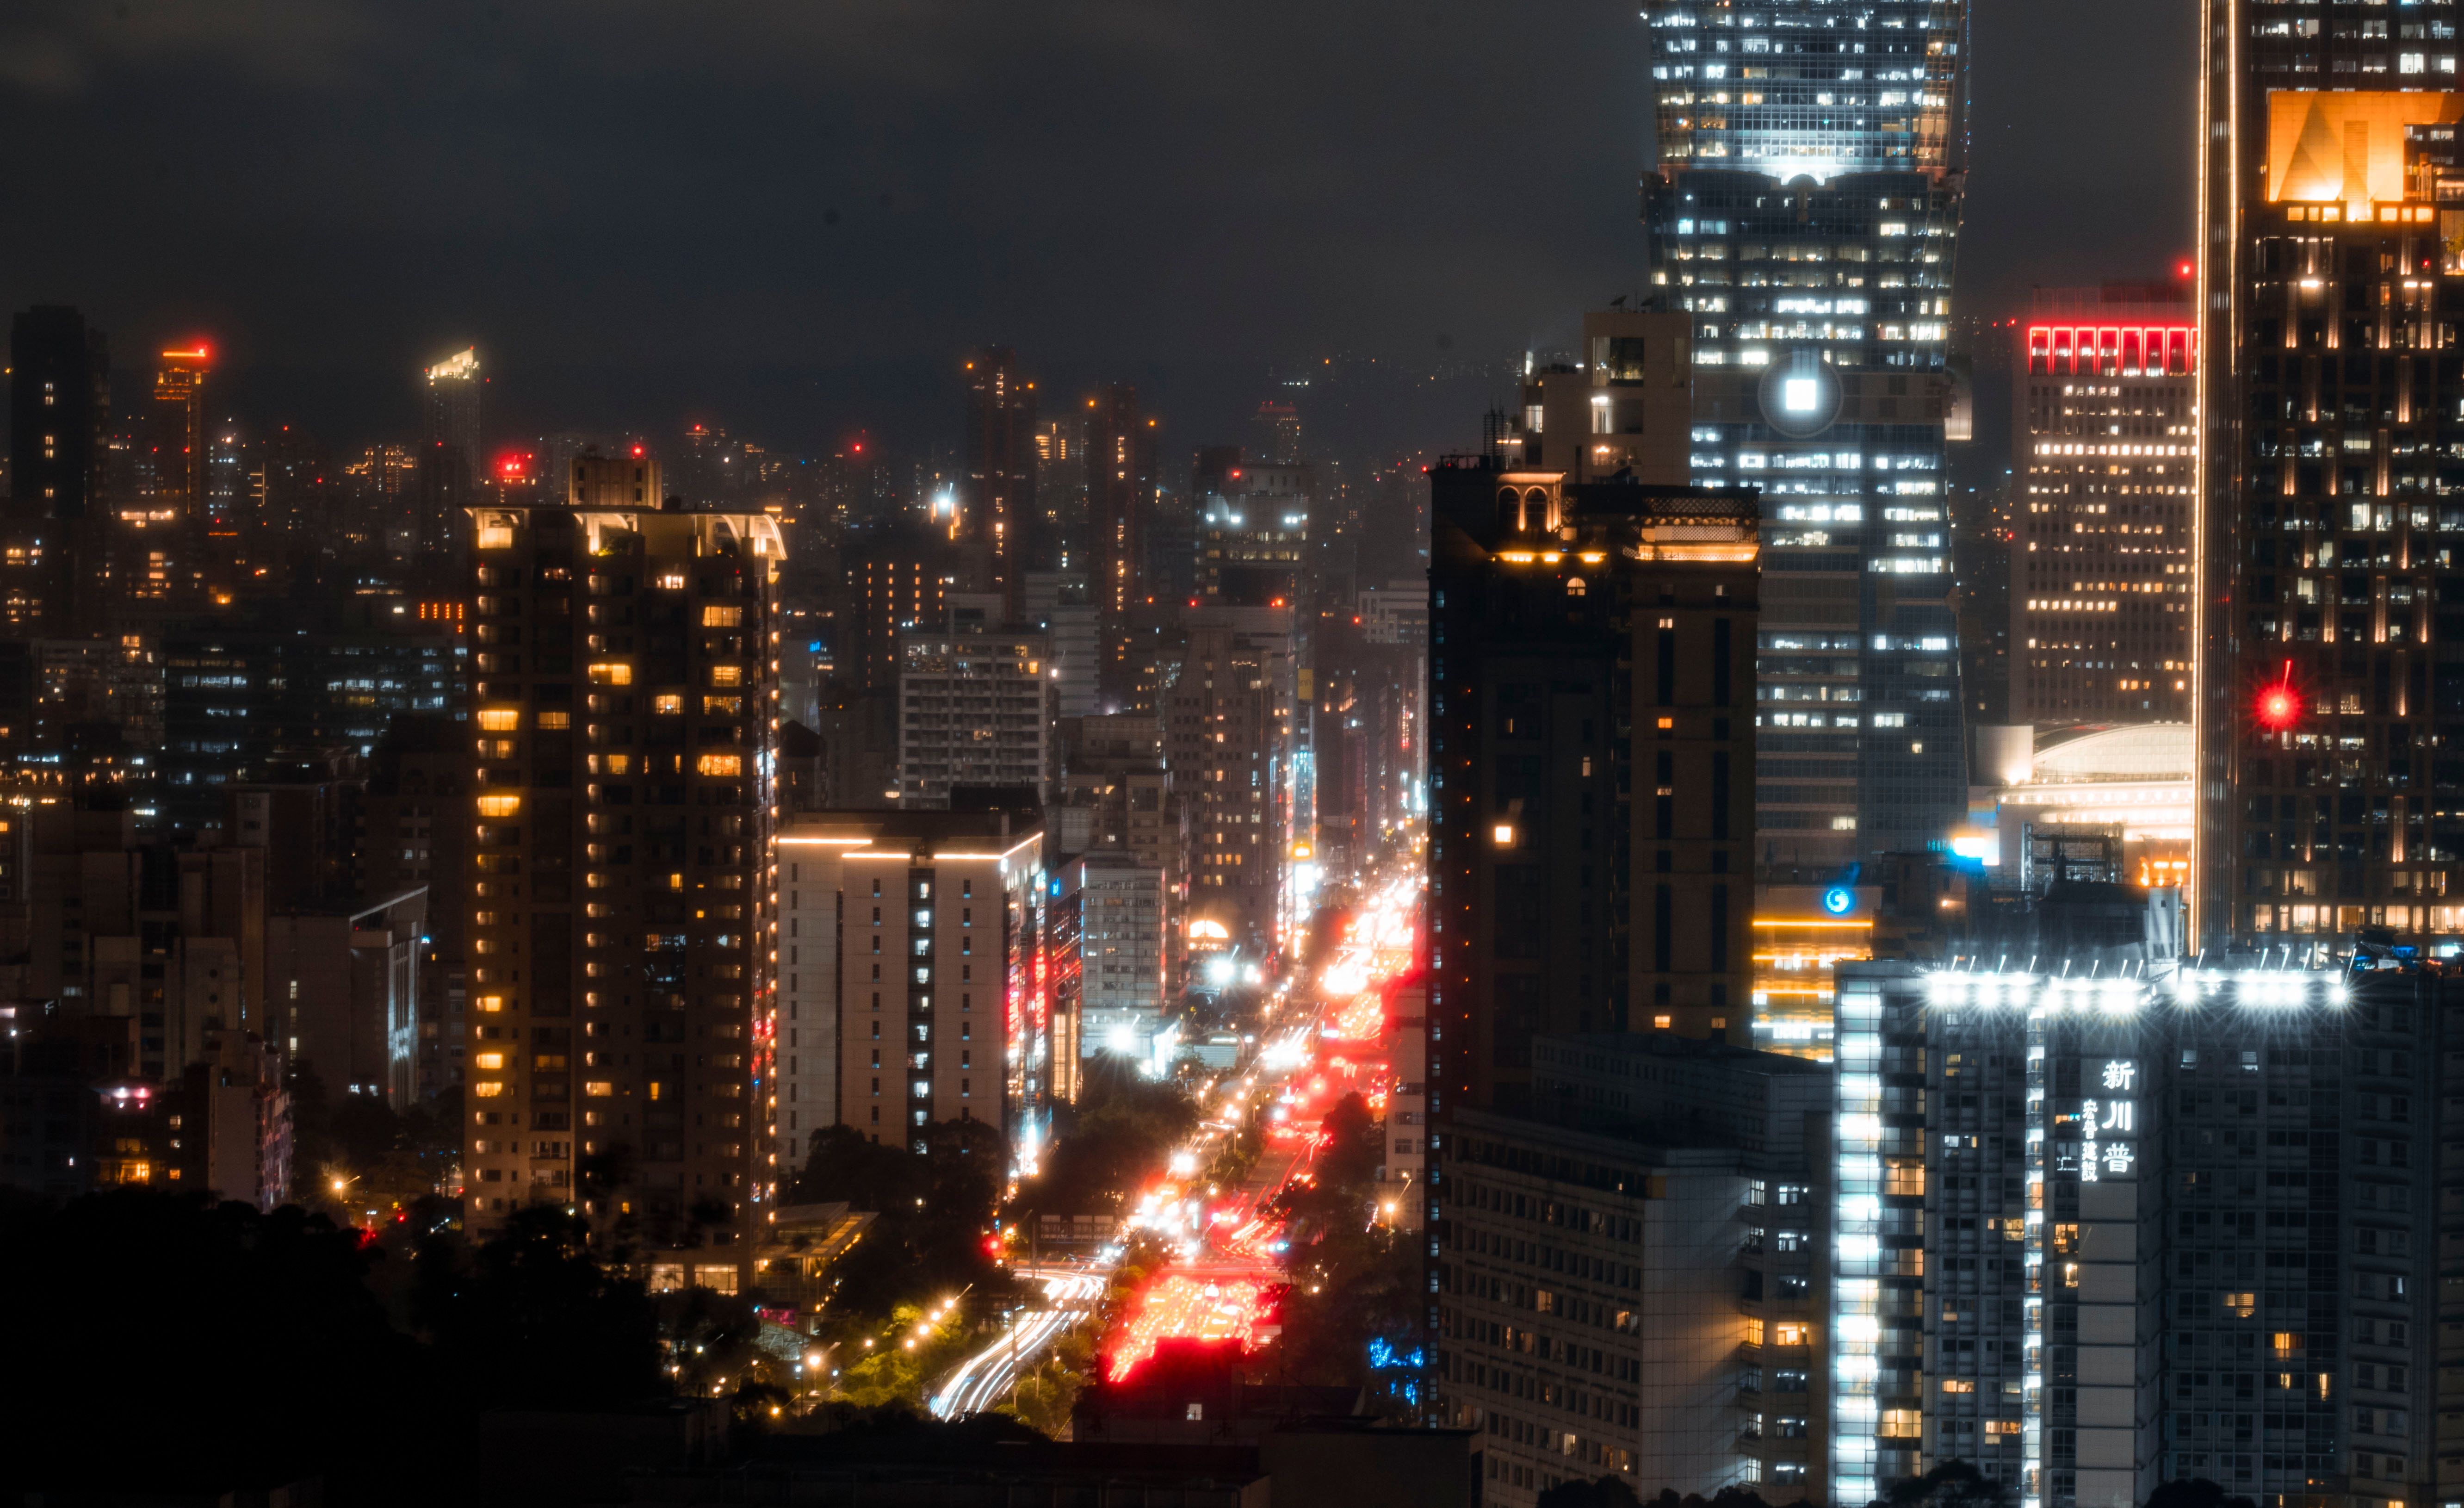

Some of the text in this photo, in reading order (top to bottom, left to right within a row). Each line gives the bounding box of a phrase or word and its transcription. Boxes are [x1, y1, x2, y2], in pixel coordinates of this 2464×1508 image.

[2081, 1098, 2098, 1182] 宏普建設
[2102, 1060, 2135, 1173] 新川普
